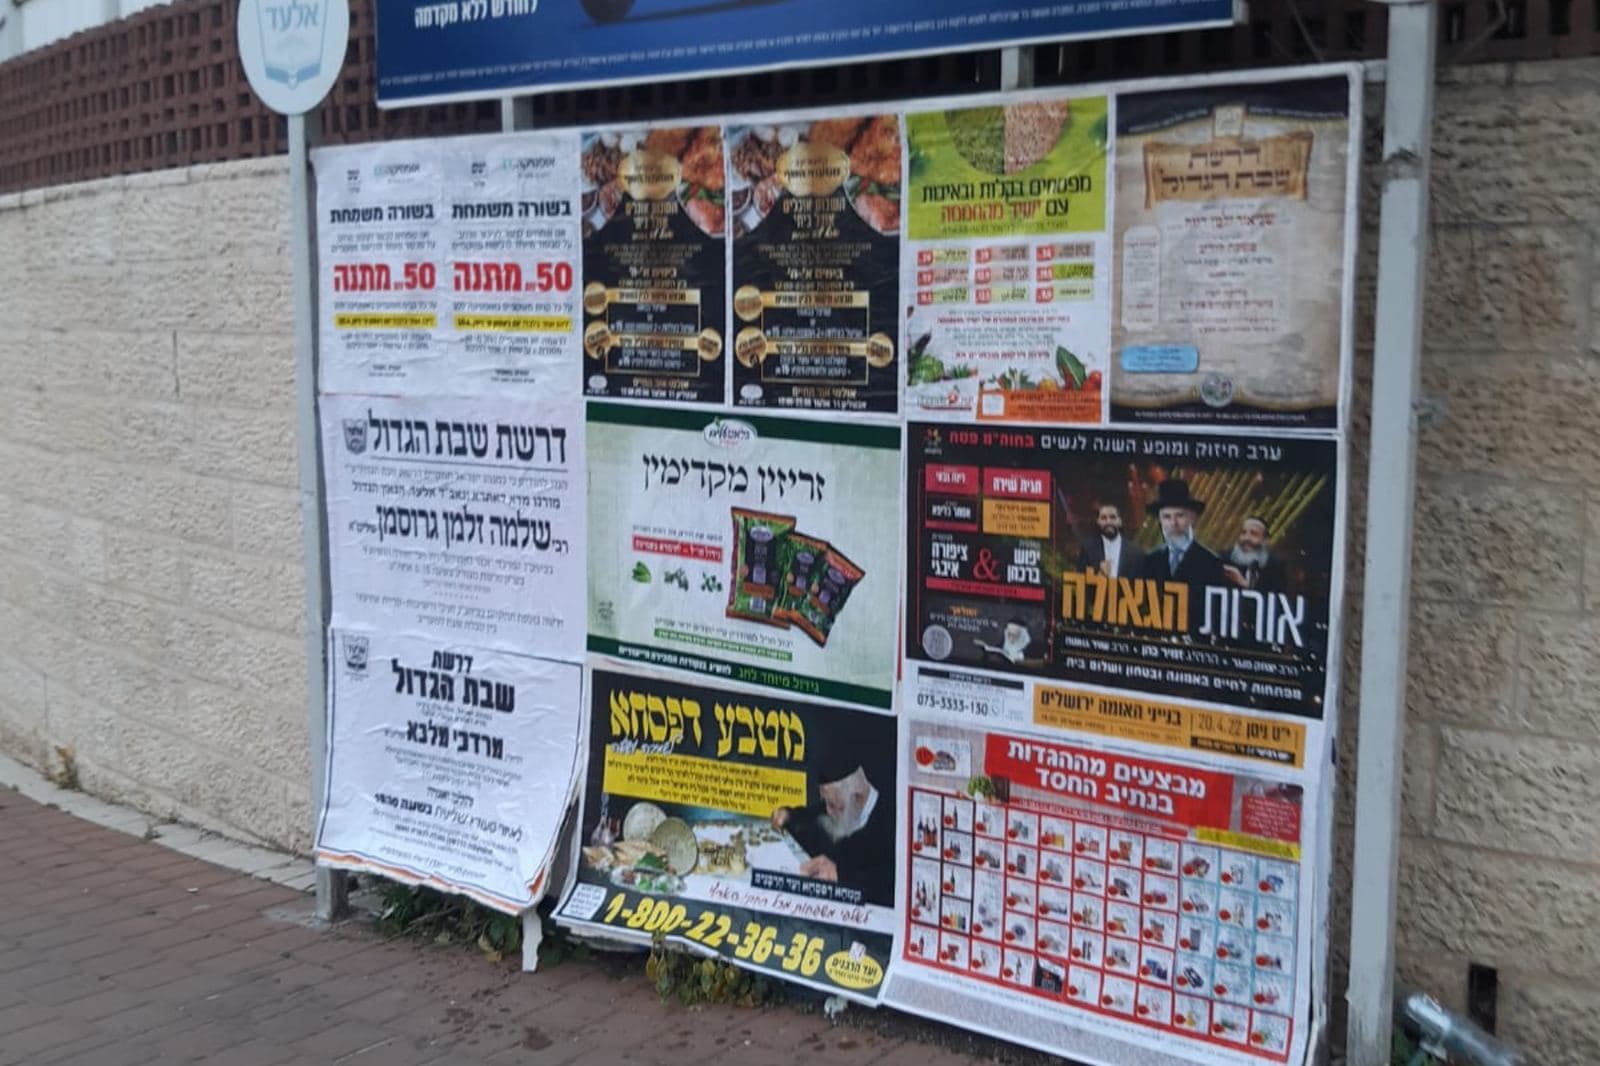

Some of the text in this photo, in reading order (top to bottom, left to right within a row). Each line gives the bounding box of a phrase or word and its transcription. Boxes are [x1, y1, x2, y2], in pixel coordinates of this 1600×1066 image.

[265, 6, 318, 32] אלעד
[414, 5, 458, 29] מקדמה
[461, 0, 488, 20] ללא
[1029, 175, 1091, 196] מפסחים
[1160, 168, 1290, 192] שבת הגדול
[923, 183, 975, 203] ובאיכות
[330, 202, 435, 224] בשורה משמחת
[452, 199, 571, 220] בשורה משמחת
[1046, 199, 1069, 216] עם
[334, 262, 436, 292] 50 מתנה
[454, 262, 573, 292] 50 מתנה
[368, 408, 566, 463] דרשת שבת הגדול
[949, 431, 977, 446] פסח
[1040, 434, 1087, 452] לנשים
[1093, 438, 1137, 455] השנה
[1143, 440, 1189, 458] ומופע
[1195, 443, 1241, 464] חיזוק
[1246, 445, 1282, 461] ערב
[643, 453, 825, 504] זריזין מקדימין
[993, 476, 1018, 493] שירה
[532, 496, 560, 510] מורנו
[376, 504, 438, 542] גרוסמן
[443, 505, 484, 549] זלמן
[489, 508, 551, 550] שלמה
[932, 541, 968, 562] ציפורה
[931, 559, 960, 579] איבגי
[972, 547, 999, 581] &
[1061, 565, 1304, 648] אורות הגאולה
[432, 650, 473, 674] דרשת
[1140, 643, 1158, 658] כהן
[392, 658, 454, 702] הגדול
[792, 675, 820, 693] גידול
[1066, 656, 1302, 700] מפתחות לחיים באמונה ובטחון ושלום בית
[463, 676, 515, 714] שבת
[1040, 689, 1182, 727] בנייני האומה ירושלים
[609, 688, 805, 761] מטבע דפסחא
[1199, 713, 1242, 734] 20.4.22
[1246, 720, 1268, 740] ניסן
[454, 728, 504, 760] מרדכי
[1007, 741, 1206, 799] מבצעים מההגדות
[1035, 767, 1173, 815] בנתיב החסד
[604, 892, 825, 977] 1-800-22-36-36
[832, 957, 878, 977] ועד הרבנים
